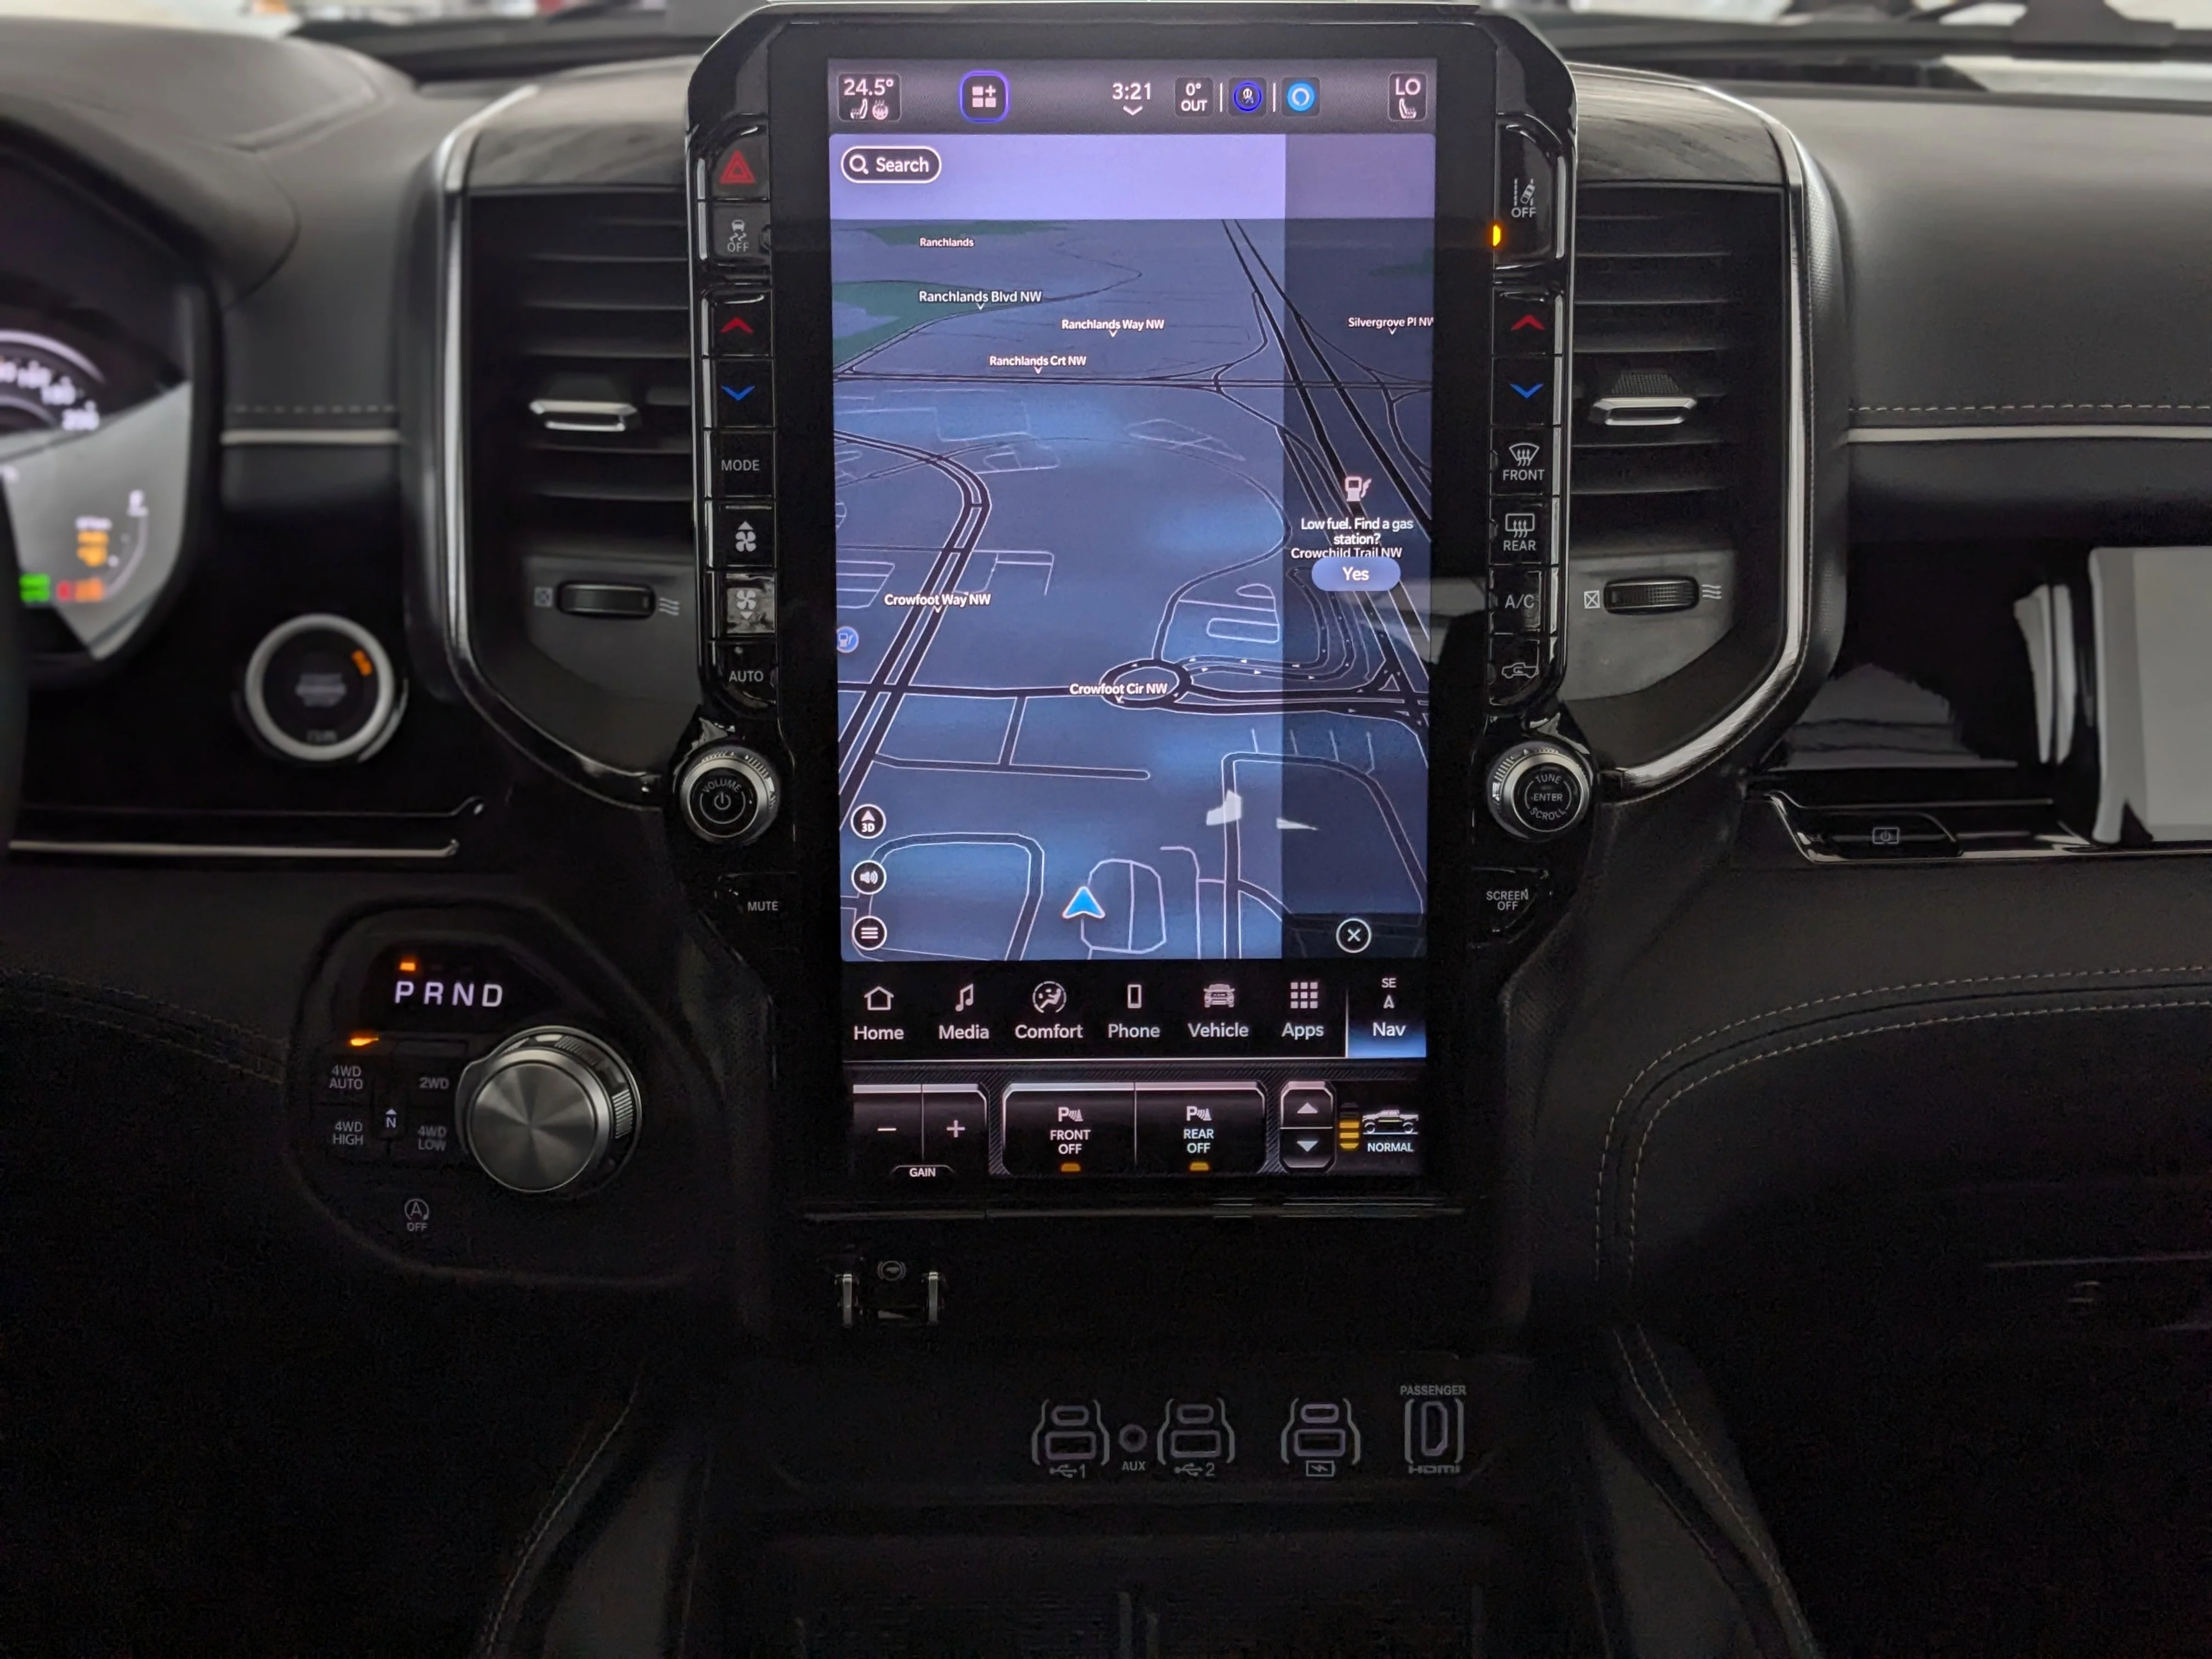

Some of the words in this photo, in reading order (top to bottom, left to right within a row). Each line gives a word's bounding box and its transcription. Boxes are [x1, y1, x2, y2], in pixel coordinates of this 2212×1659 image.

[843, 78, 894, 96] 24.5°
[1112, 82, 1151, 100] 3:21
[1186, 82, 1201, 97] 0°
[1395, 78, 1421, 95] LO
[1181, 100, 1207, 111] OUT
[876, 157, 929, 173] Search
[1511, 207, 1536, 218] OFF
[727, 242, 749, 252] OFF
[919, 238, 974, 247] Ranchlands
[919, 290, 989, 303] Ranchlands
[991, 291, 1019, 302] Blvd
[1021, 291, 1042, 302] NW
[1062, 319, 1121, 330] Ranchlands
[1122, 319, 1144, 331] Way
[1146, 319, 1165, 329] NW
[1348, 317, 1406, 329] Silvergrove
[989, 356, 1048, 366] Ranchlands
[1050, 356, 1066, 366] Crt
[1068, 356, 1087, 366] NW
[721, 460, 760, 471] MODE
[1503, 470, 1545, 481] FRONT
[1301, 518, 1325, 530] Low
[1327, 517, 1352, 530] fuel.
[1354, 517, 1380, 529] Find
[1383, 521, 1390, 530] a
[1391, 521, 1414, 533] gas
[1333, 533, 1381, 545] station?
[1503, 540, 1536, 551] REAR
[1290, 548, 1351, 558] Crowchild
[1353, 548, 1378, 557] Trail
[1381, 548, 1402, 558] NW
[1342, 567, 1370, 581] Yes
[884, 594, 940, 606] Crowfoot
[941, 594, 968, 608] Way
[969, 594, 991, 605] NW
[1504, 594, 1535, 609] A/C
[729, 670, 764, 682] AUTO
[1069, 683, 1125, 695] Crowfoot
[1126, 684, 1144, 695] Cir
[1146, 684, 1168, 695] NW
[702, 778, 742, 793] VOLUME
[1535, 774, 1562, 785] TUNE
[1533, 793, 1563, 802] ENTER
[1529, 807, 1566, 820] SCROLL
[861, 823, 875, 833] 3D
[1486, 890, 1529, 901] SCREEN
[747, 901, 778, 911] MUTE
[1497, 901, 1518, 911] OFF
[1381, 978, 1397, 988] SE
[853, 1026, 904, 1041] Home
[938, 1024, 990, 1040] Media
[1014, 1024, 1084, 1039] Comfort
[1108, 1024, 1160, 1038] Phone
[1187, 1023, 1249, 1038] Vehicle
[1282, 1023, 1324, 1041] Apps
[1372, 1023, 1406, 1037] Nav
[331, 1065, 361, 1078] 4WD
[329, 1078, 363, 1090] AUTO
[419, 1077, 449, 1090] 2WD
[334, 1121, 363, 1132] 4WD
[386, 1117, 397, 1128] N
[417, 1126, 447, 1138] 4WD
[1049, 1130, 1091, 1141] FRONT
[1183, 1129, 1214, 1139] REAR
[332, 1133, 364, 1146] HIGH
[418, 1138, 447, 1151] LOW
[1058, 1144, 1082, 1154] OFF
[1187, 1143, 1211, 1153] OFF
[1367, 1142, 1413, 1153] NORMAL
[909, 1167, 936, 1177] GAIN
[407, 1222, 427, 1232] OFF
[1400, 1385, 1466, 1396] PASSENGER
[1121, 1461, 1146, 1471] AUX
[1205, 1463, 1215, 1477] 2
[1408, 1465, 1461, 1474] HDMI
